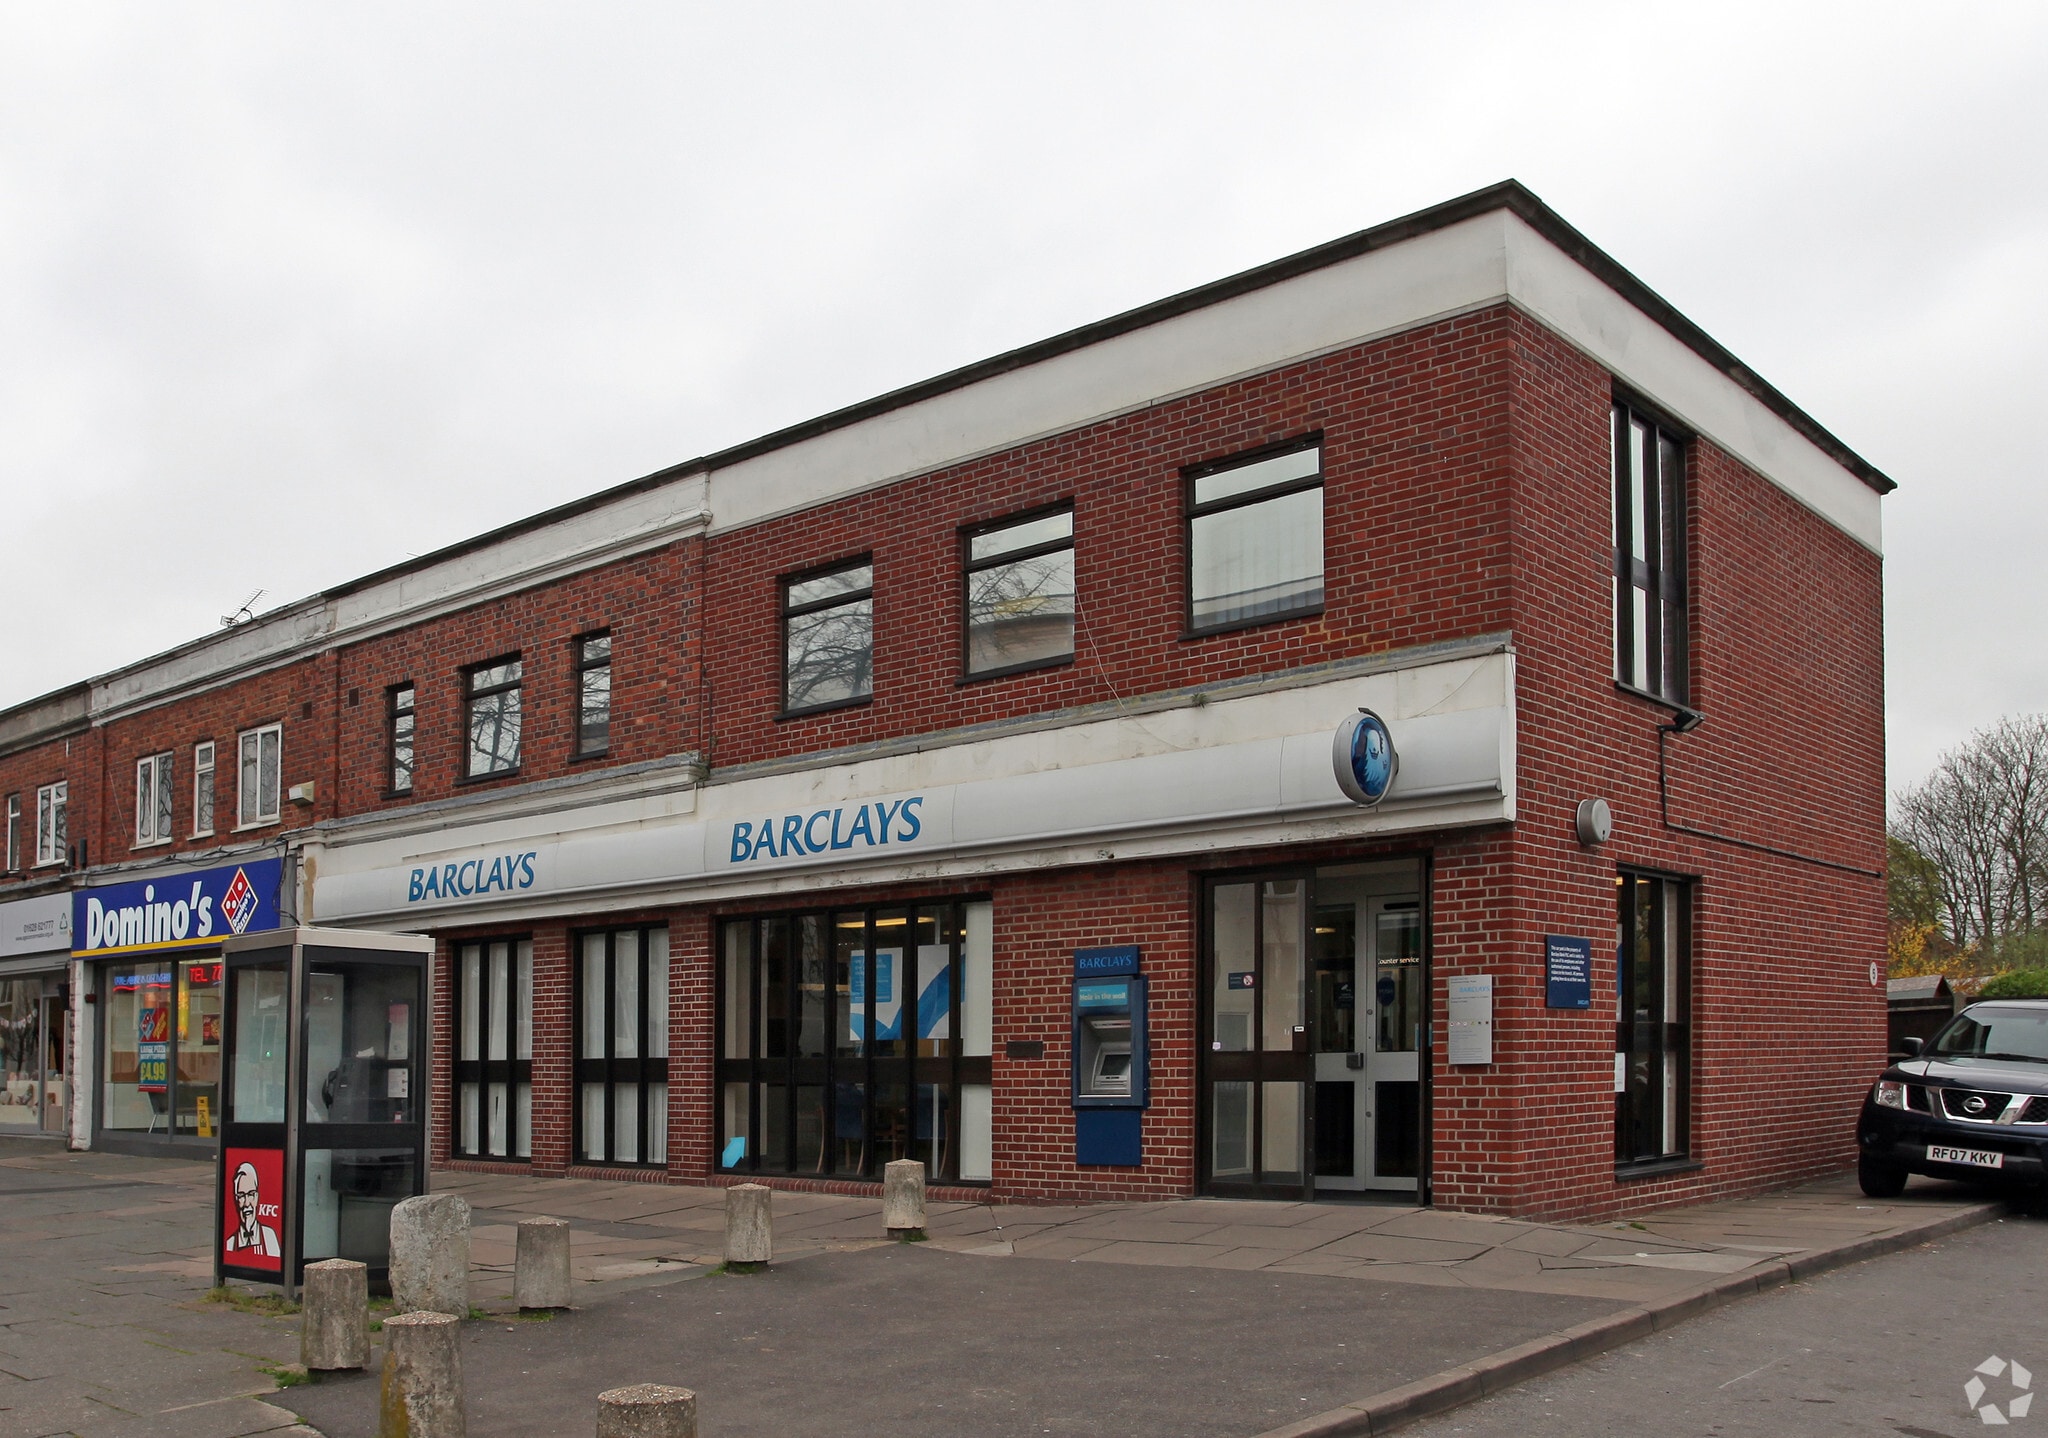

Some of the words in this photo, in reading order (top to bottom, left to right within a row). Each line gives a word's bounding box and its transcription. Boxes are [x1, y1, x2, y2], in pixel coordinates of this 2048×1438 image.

[730, 797, 923, 863] BARCLAYS
[408, 852, 536, 901] BARCLAYS
[87, 881, 212, 950] Domino's
[1080, 955, 1131, 968] BARCLAYS
[1399, 956, 1419, 964] service
[189, 967, 208, 982] TEL
[141, 1061, 166, 1081] £4.99
[1932, 1147, 1967, 1162] RF07
[1970, 1151, 1997, 1165] KKV
[259, 1204, 278, 1217] KFC
